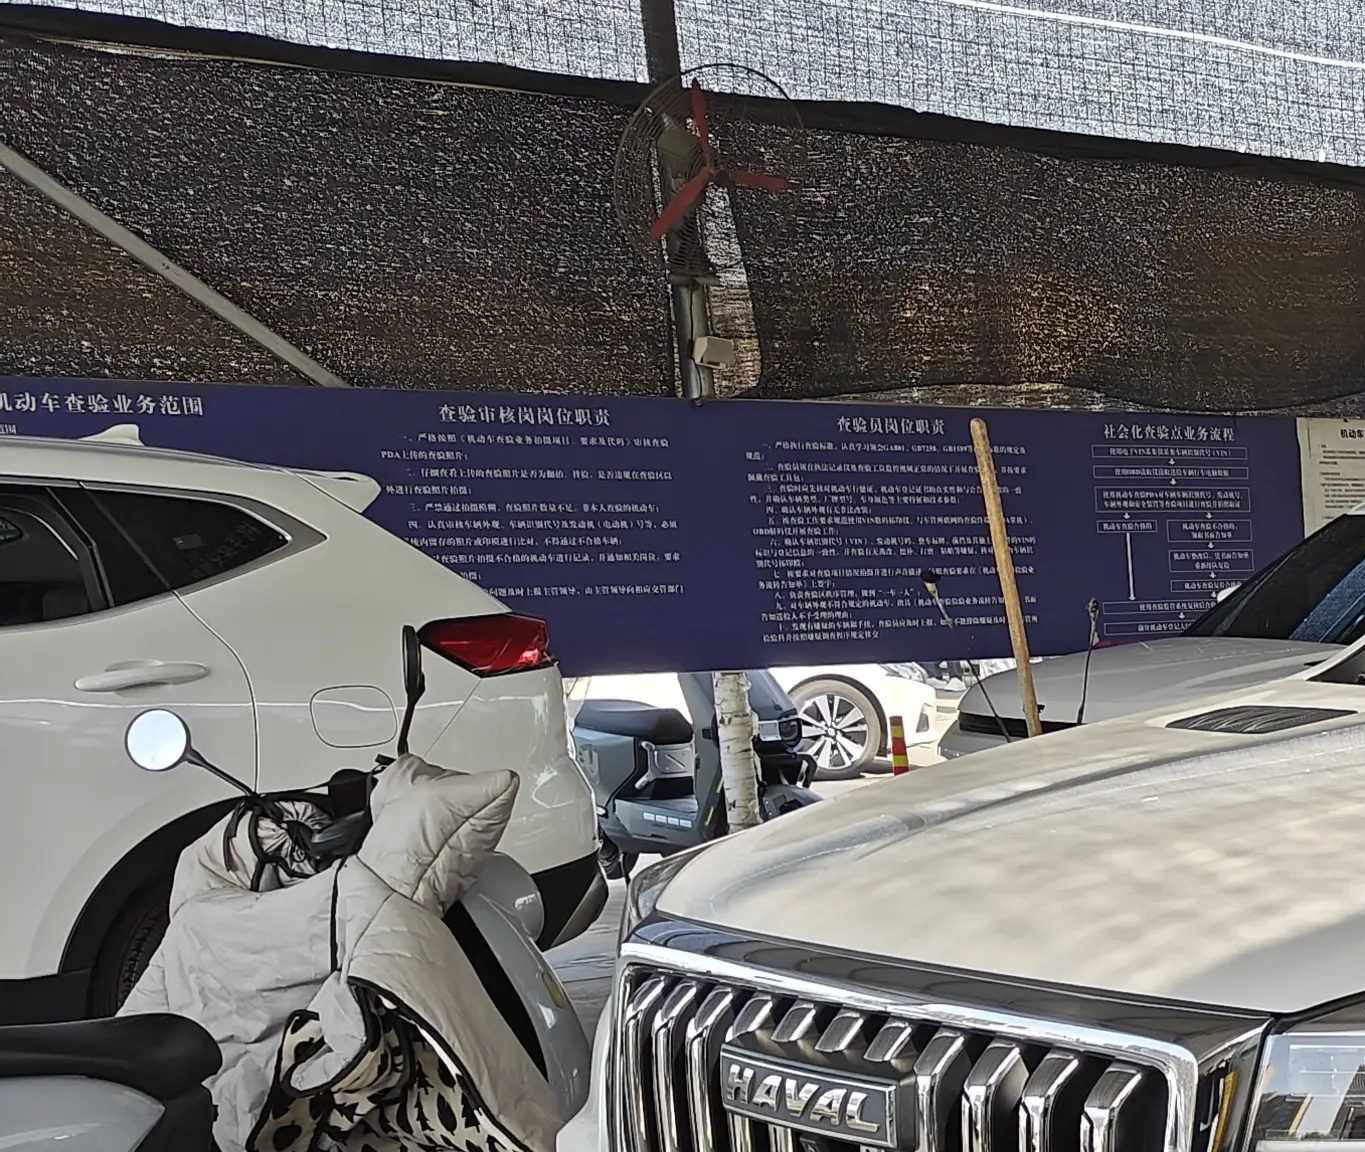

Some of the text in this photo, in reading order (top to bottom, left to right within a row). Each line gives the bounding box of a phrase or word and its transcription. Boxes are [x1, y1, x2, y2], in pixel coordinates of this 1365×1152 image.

[837, 416, 945, 435] 查验员岗位职责
[1103, 424, 1235, 442] 社会化查验点业务流程
[727, 1063, 881, 1133] HAVAL
